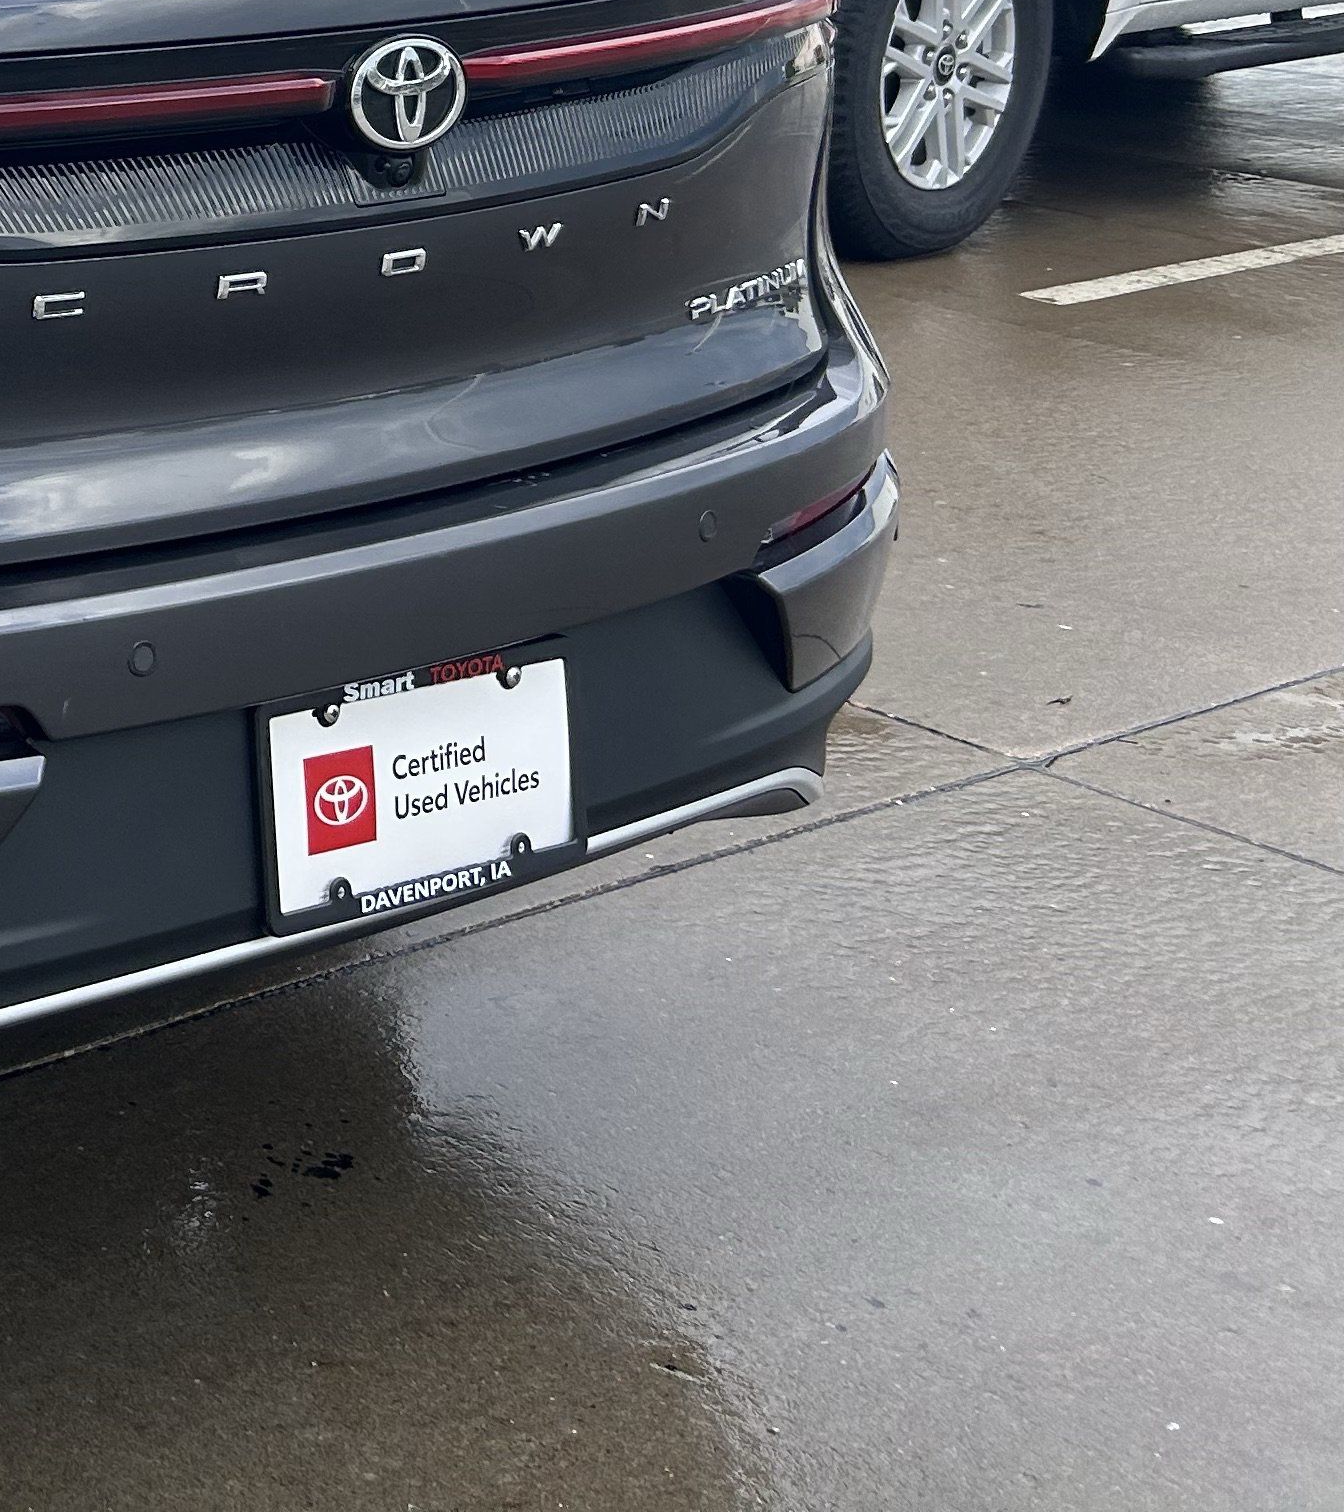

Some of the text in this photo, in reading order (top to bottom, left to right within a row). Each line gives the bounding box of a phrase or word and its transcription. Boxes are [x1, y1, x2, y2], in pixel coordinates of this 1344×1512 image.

[32, 199, 670, 319] CROWN
[343, 654, 505, 703] Smart TOYOTA
[392, 736, 486, 780] Certified
[395, 768, 540, 819] Used Vehicles
[361, 860, 512, 913] DAVENPORT, IA
